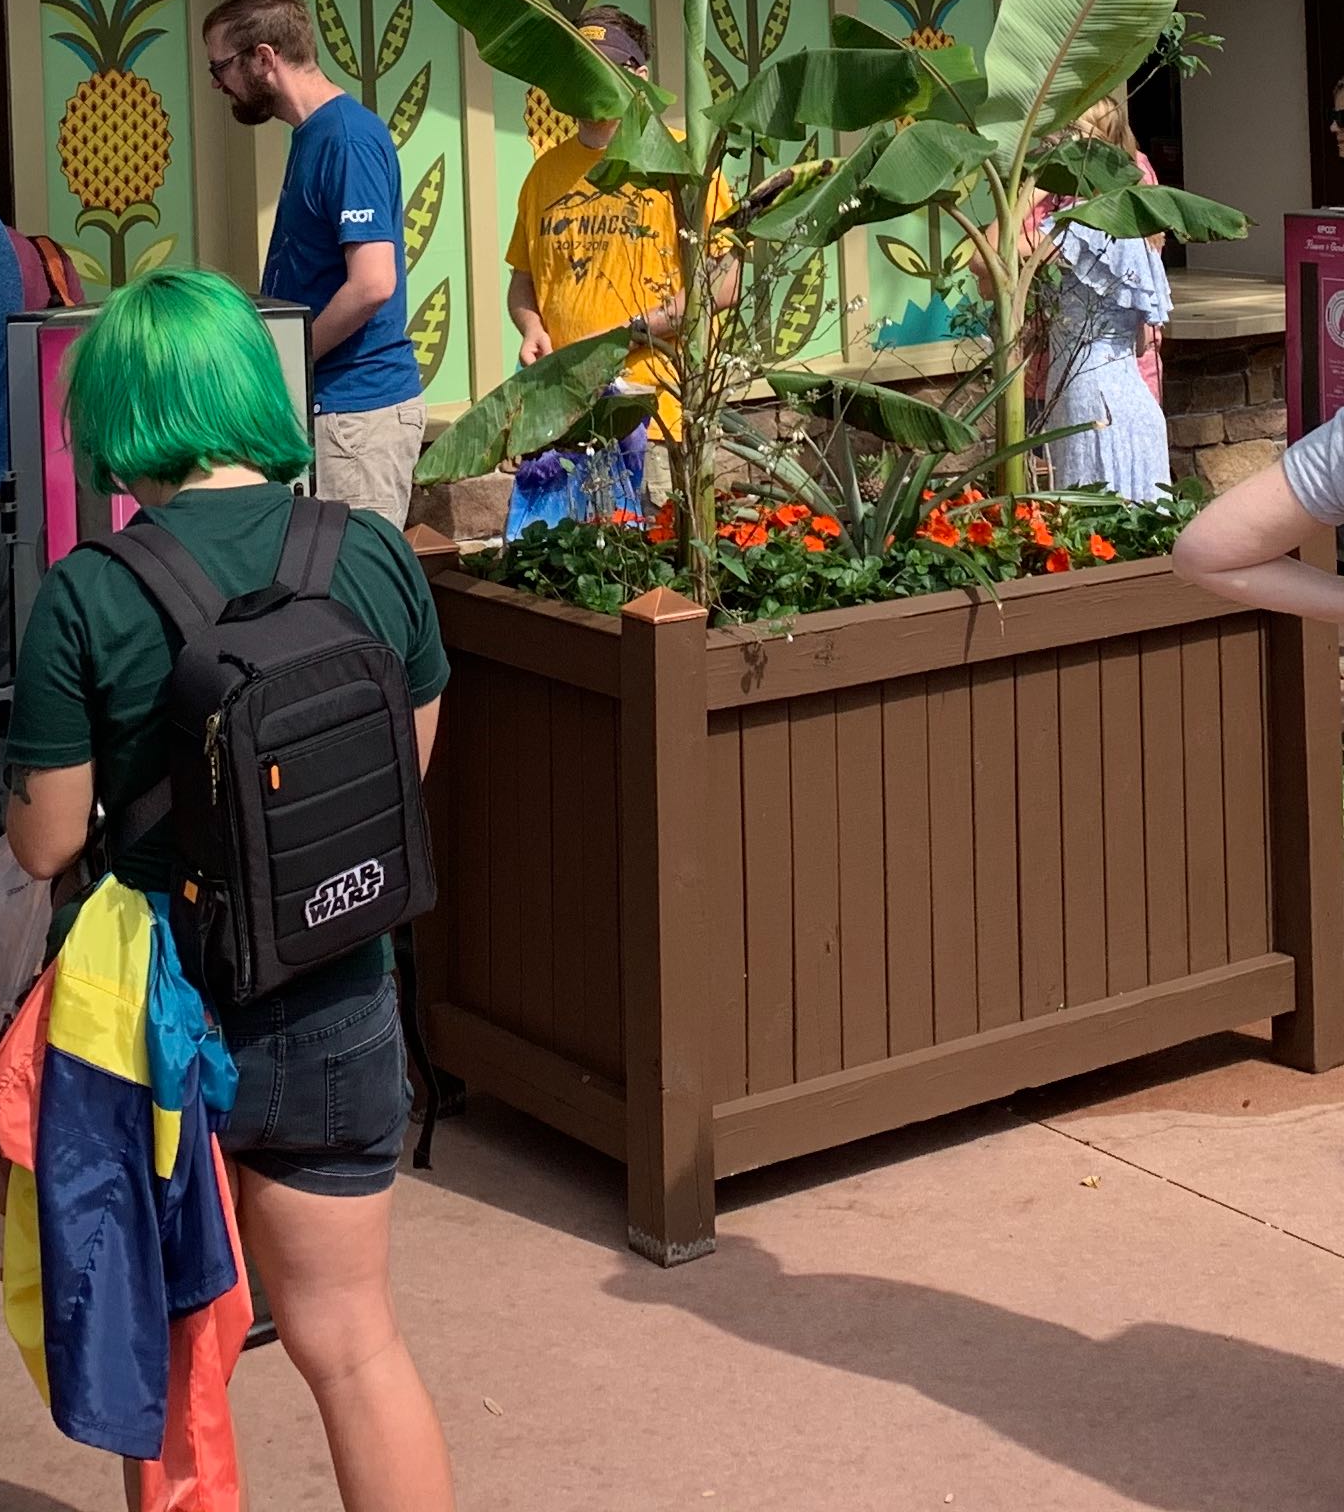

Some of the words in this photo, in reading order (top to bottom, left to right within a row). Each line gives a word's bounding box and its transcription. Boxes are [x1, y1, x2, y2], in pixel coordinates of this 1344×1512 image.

[339, 209, 375, 225] PCOT
[555, 240, 609, 252] 2017-2018
[309, 863, 380, 908] STAR
[309, 878, 380, 924] WARS
